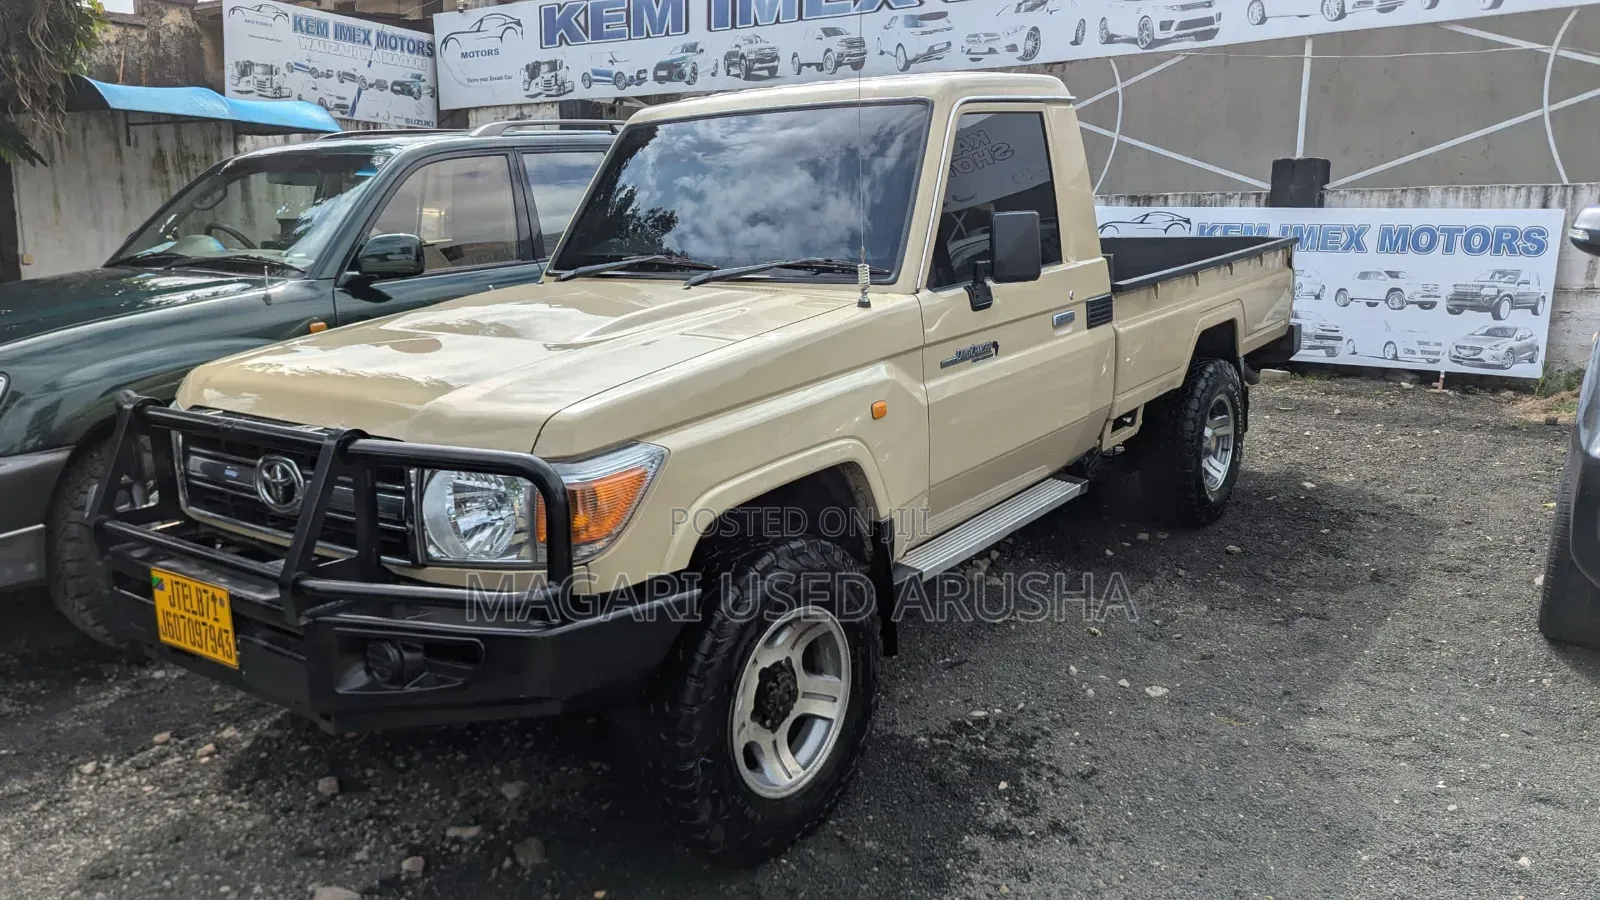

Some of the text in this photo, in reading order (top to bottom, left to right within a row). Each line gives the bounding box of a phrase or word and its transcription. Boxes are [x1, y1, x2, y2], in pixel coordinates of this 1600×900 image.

[292, 13, 435, 59] KEM IMEX MOTORS
[539, 0, 924, 49] KEM IM
[461, 48, 500, 59] MOTORS
[405, 118, 434, 128] SUZUKI
[1376, 224, 1549, 257] MOTORS
